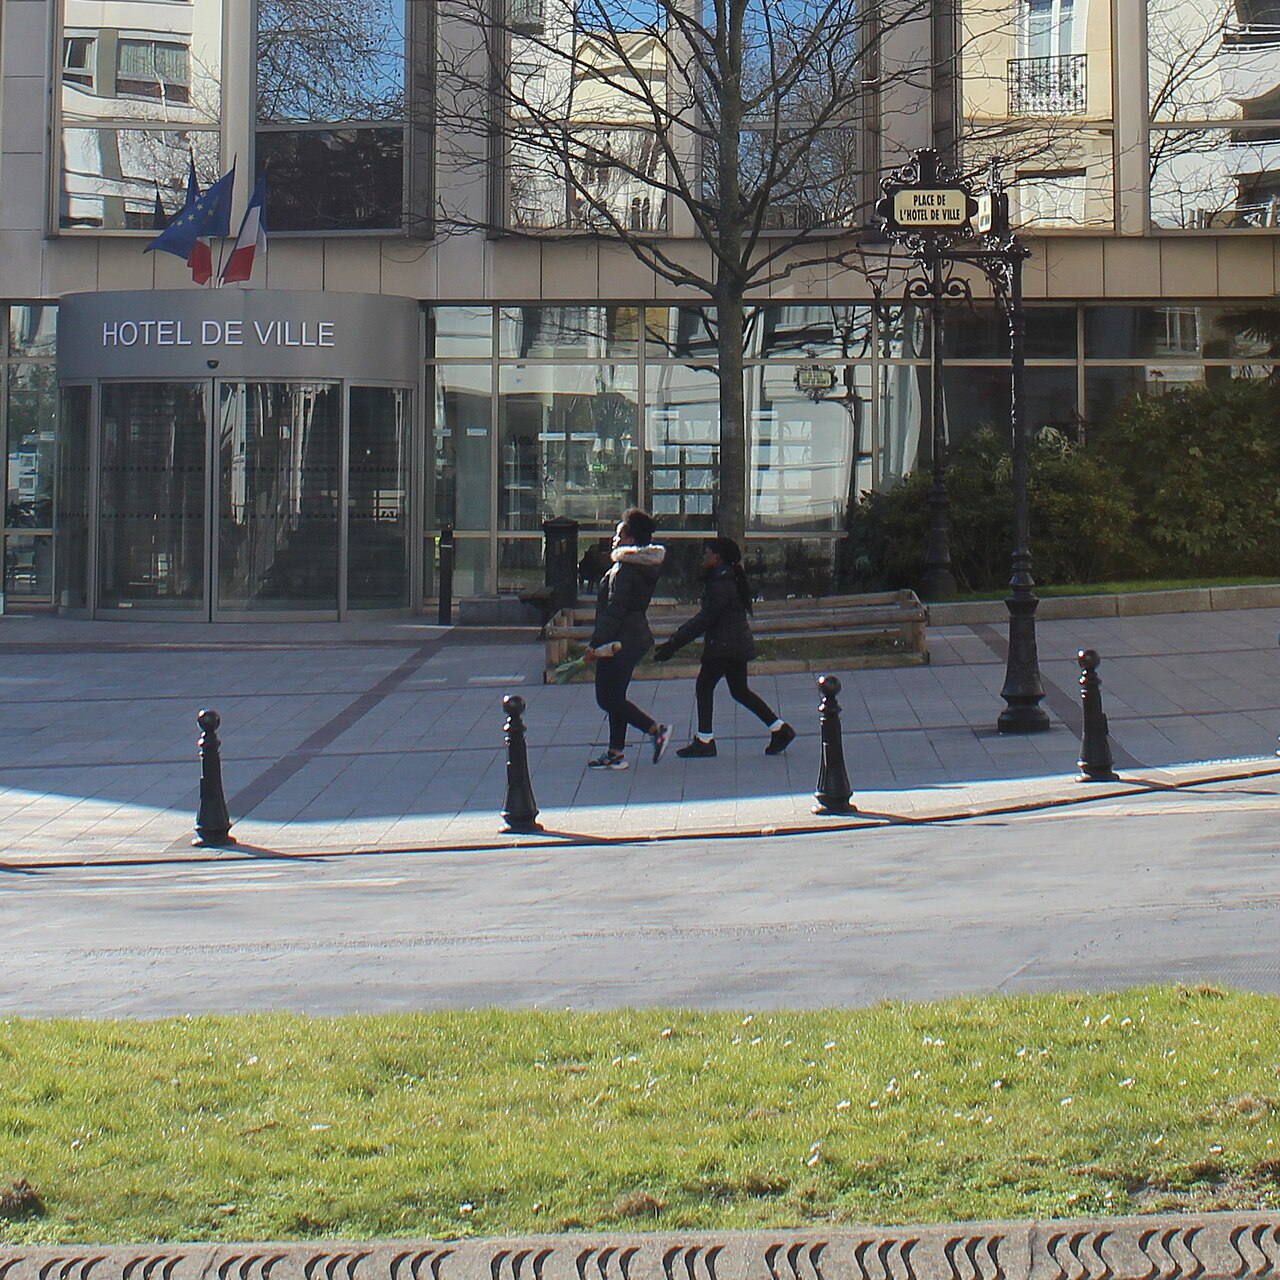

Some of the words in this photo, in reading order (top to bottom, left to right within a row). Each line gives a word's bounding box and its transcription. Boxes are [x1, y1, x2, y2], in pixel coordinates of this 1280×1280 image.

[913, 194, 935, 207] PLACE
[937, 194, 946, 206] DE
[931, 209, 940, 221] DE
[942, 209, 960, 221] VILLE
[102, 320, 192, 346] HOTEL
[201, 320, 243, 345] DE
[253, 320, 335, 347] VILLE
